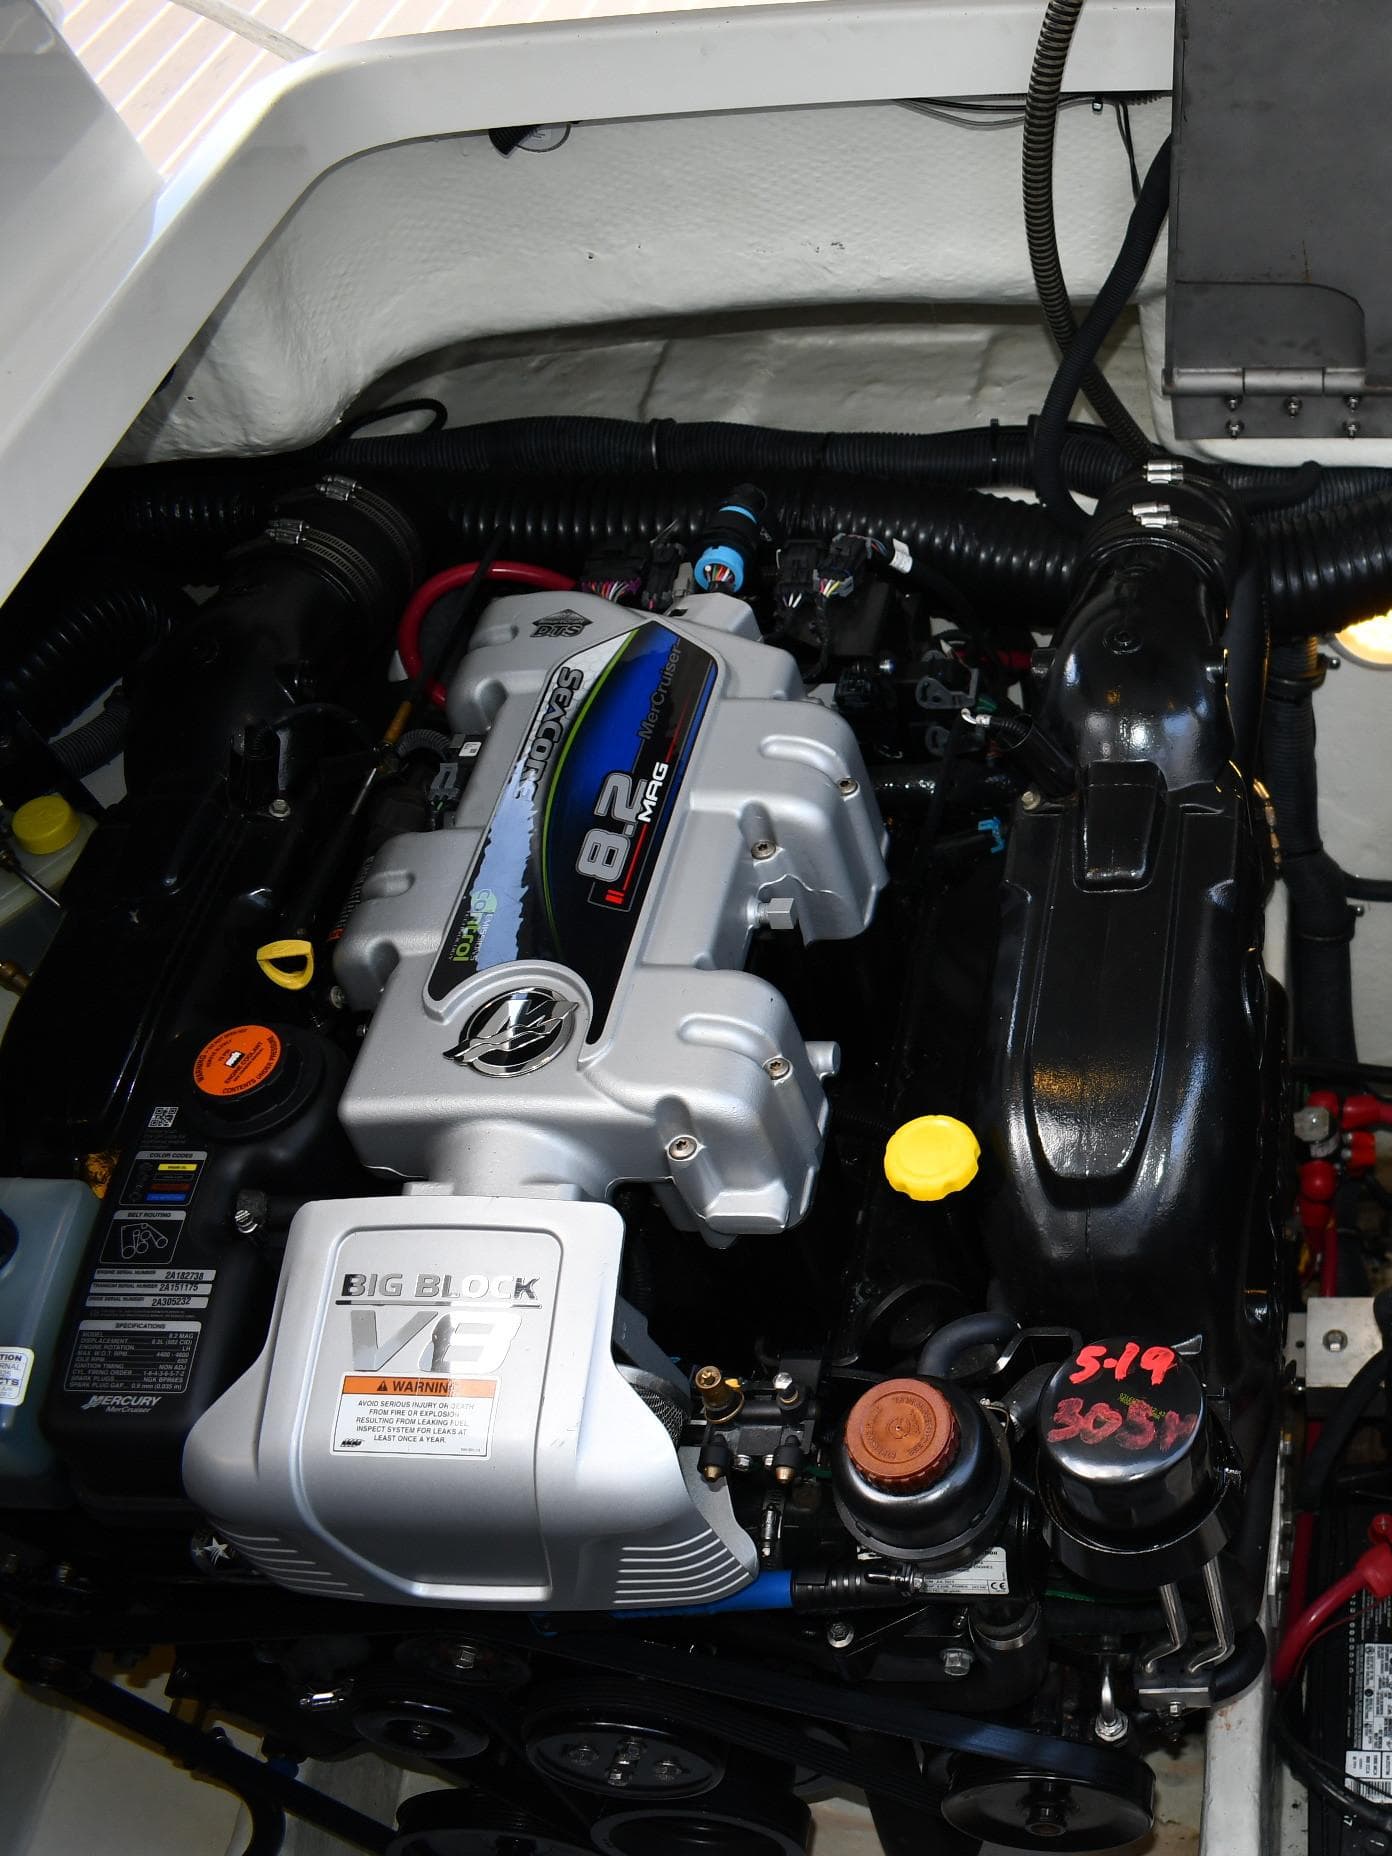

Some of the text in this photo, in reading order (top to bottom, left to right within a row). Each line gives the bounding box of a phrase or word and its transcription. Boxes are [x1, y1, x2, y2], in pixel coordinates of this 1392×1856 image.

[530, 624, 585, 638] DTS
[638, 642, 681, 741] MerCruiser
[515, 666, 585, 799] SEACORE
[637, 762, 669, 823] MAG
[575, 772, 648, 883] 8.2
[341, 1273, 540, 1300] BIG BLOCK
[350, 1310, 523, 1374] V8
[1069, 1341, 1176, 1386] 5-19
[88, 1396, 162, 1408] MERCURY
[392, 1380, 456, 1395] WARNIN
[991, 1581, 1007, 1590] CE
